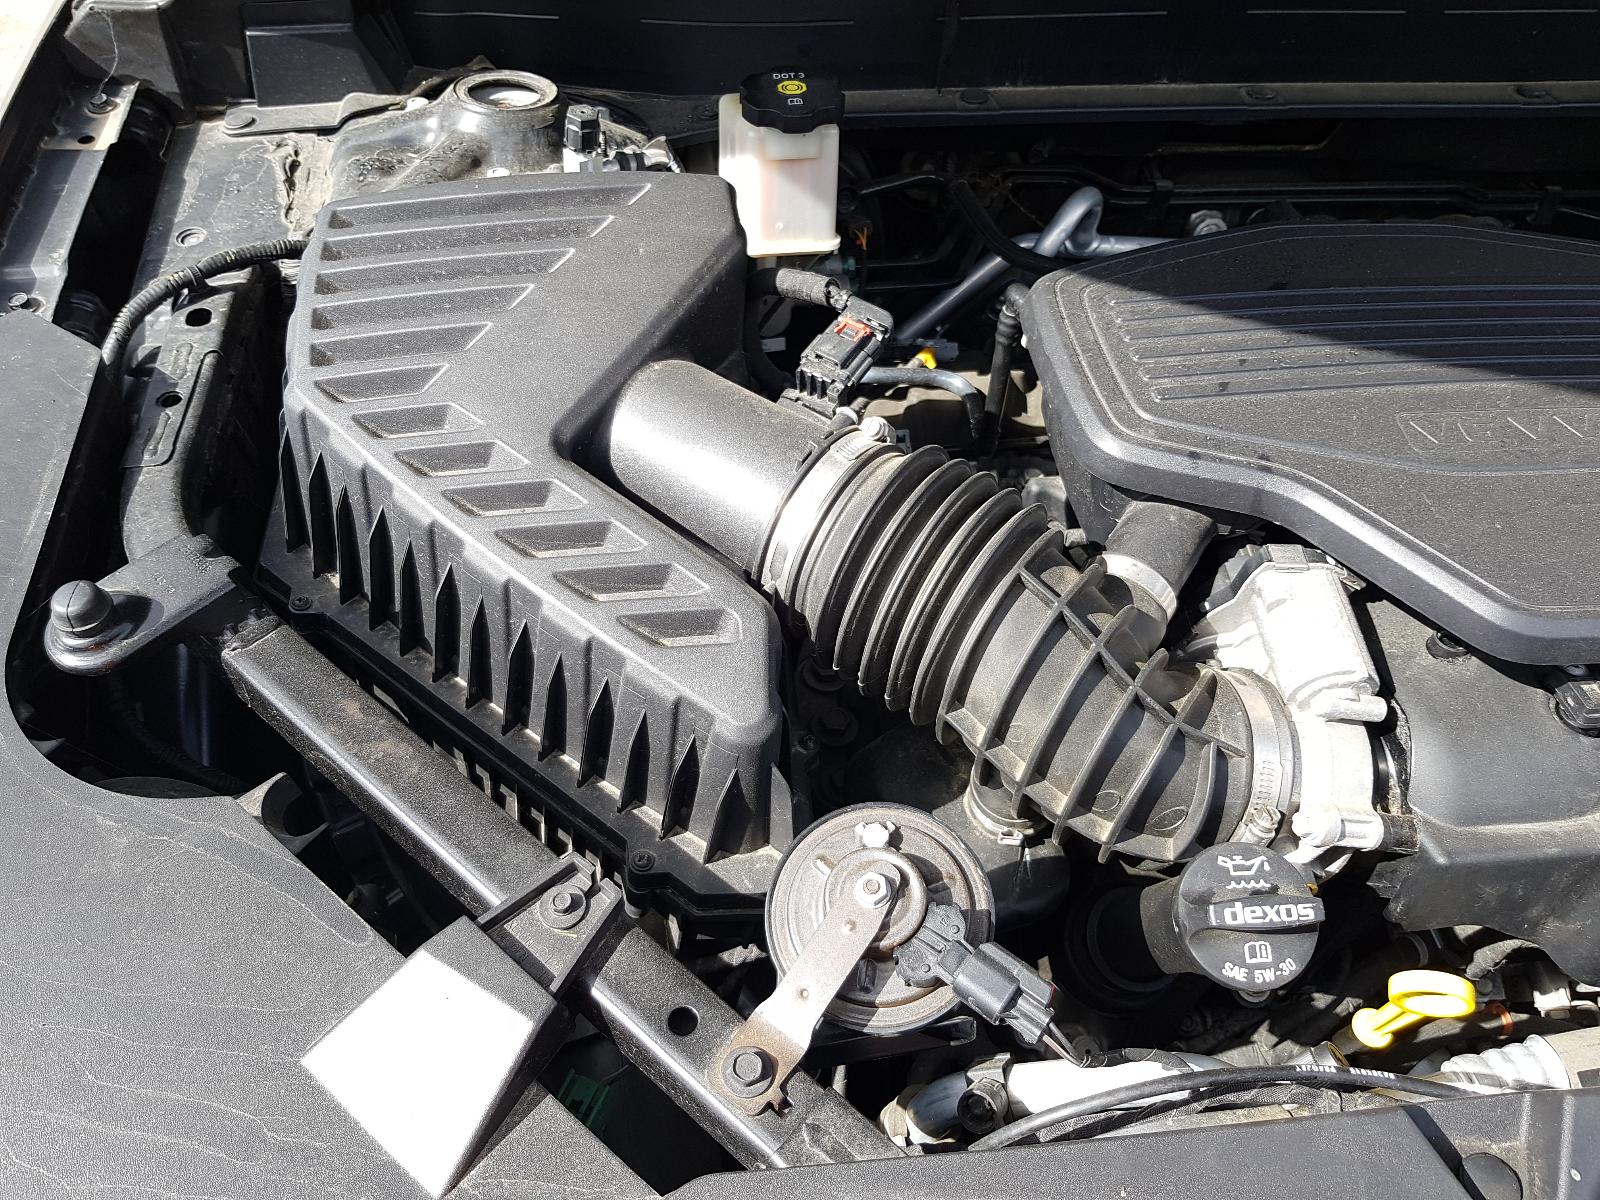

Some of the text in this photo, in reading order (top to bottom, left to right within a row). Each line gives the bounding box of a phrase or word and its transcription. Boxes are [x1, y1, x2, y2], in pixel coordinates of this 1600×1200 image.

[773, 72, 795, 80] DOT
[1223, 901, 1316, 925] dexos
[1221, 957, 1297, 983] SAE 5W-30
